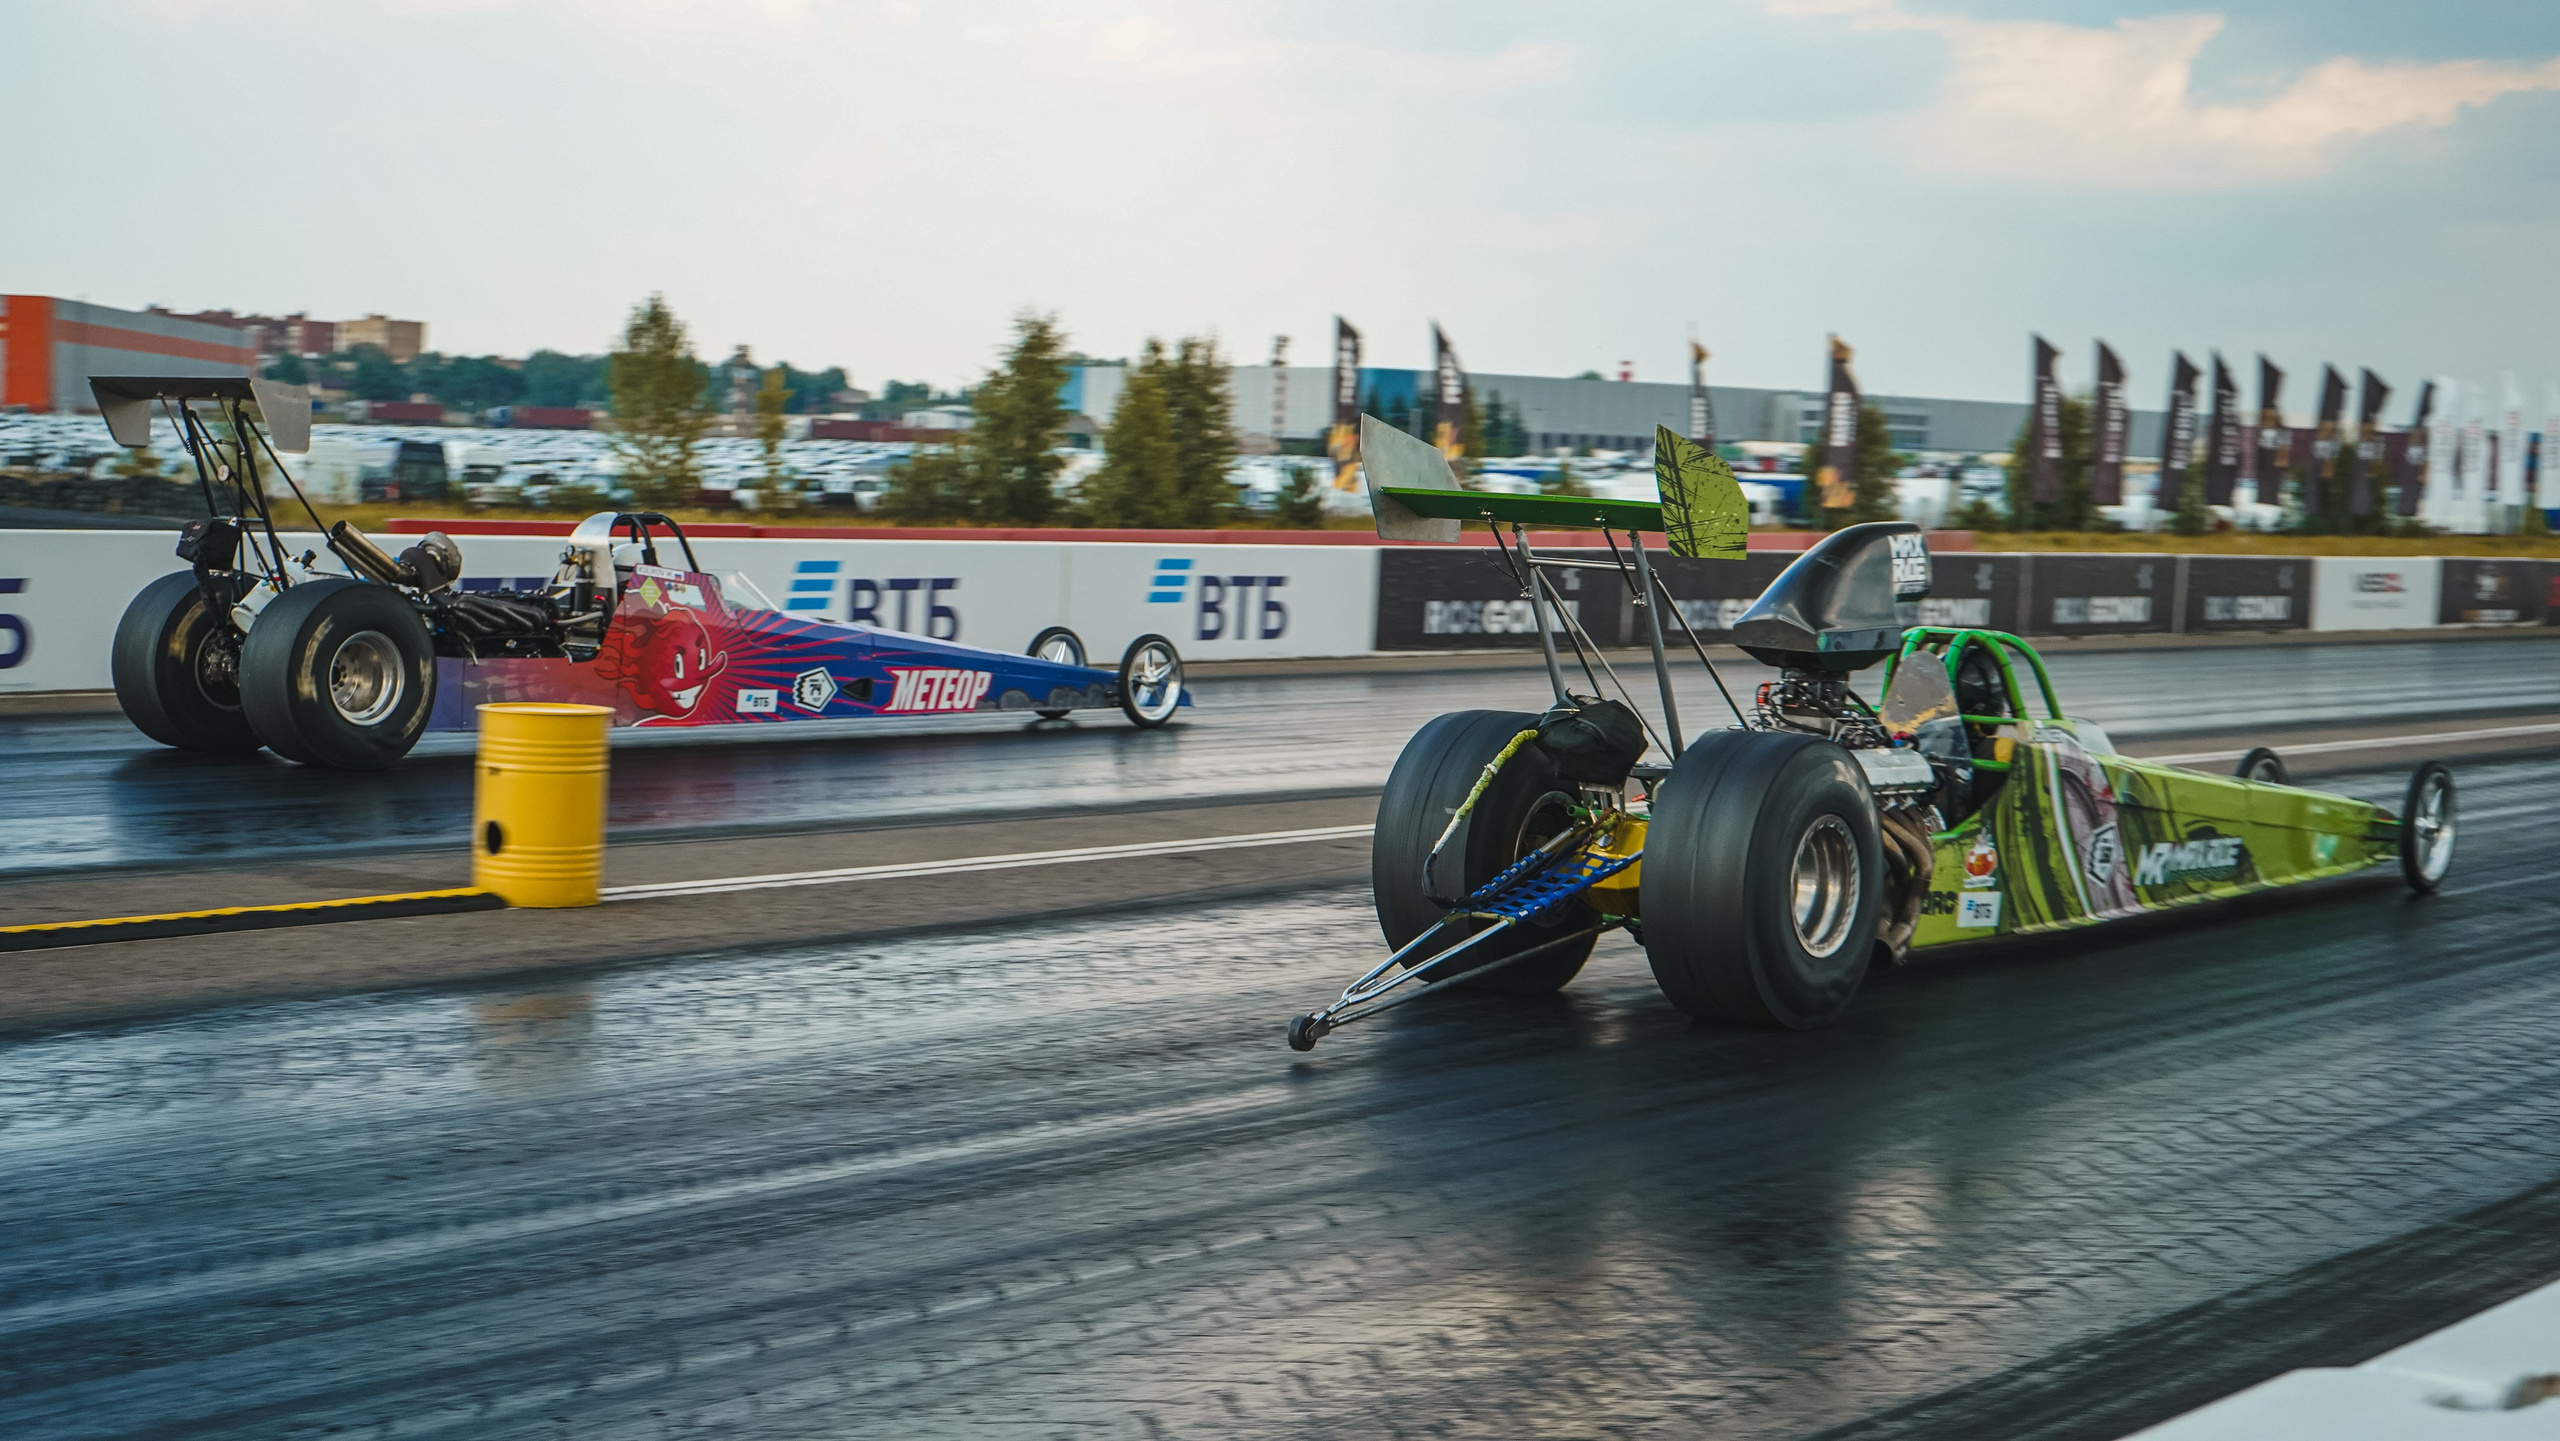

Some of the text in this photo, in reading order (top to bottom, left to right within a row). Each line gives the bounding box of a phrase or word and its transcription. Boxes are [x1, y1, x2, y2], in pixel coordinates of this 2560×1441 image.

[849, 577, 962, 641] ВТБ
[1197, 575, 1288, 640] ВТБ
[752, 695, 770, 707] ВТБ
